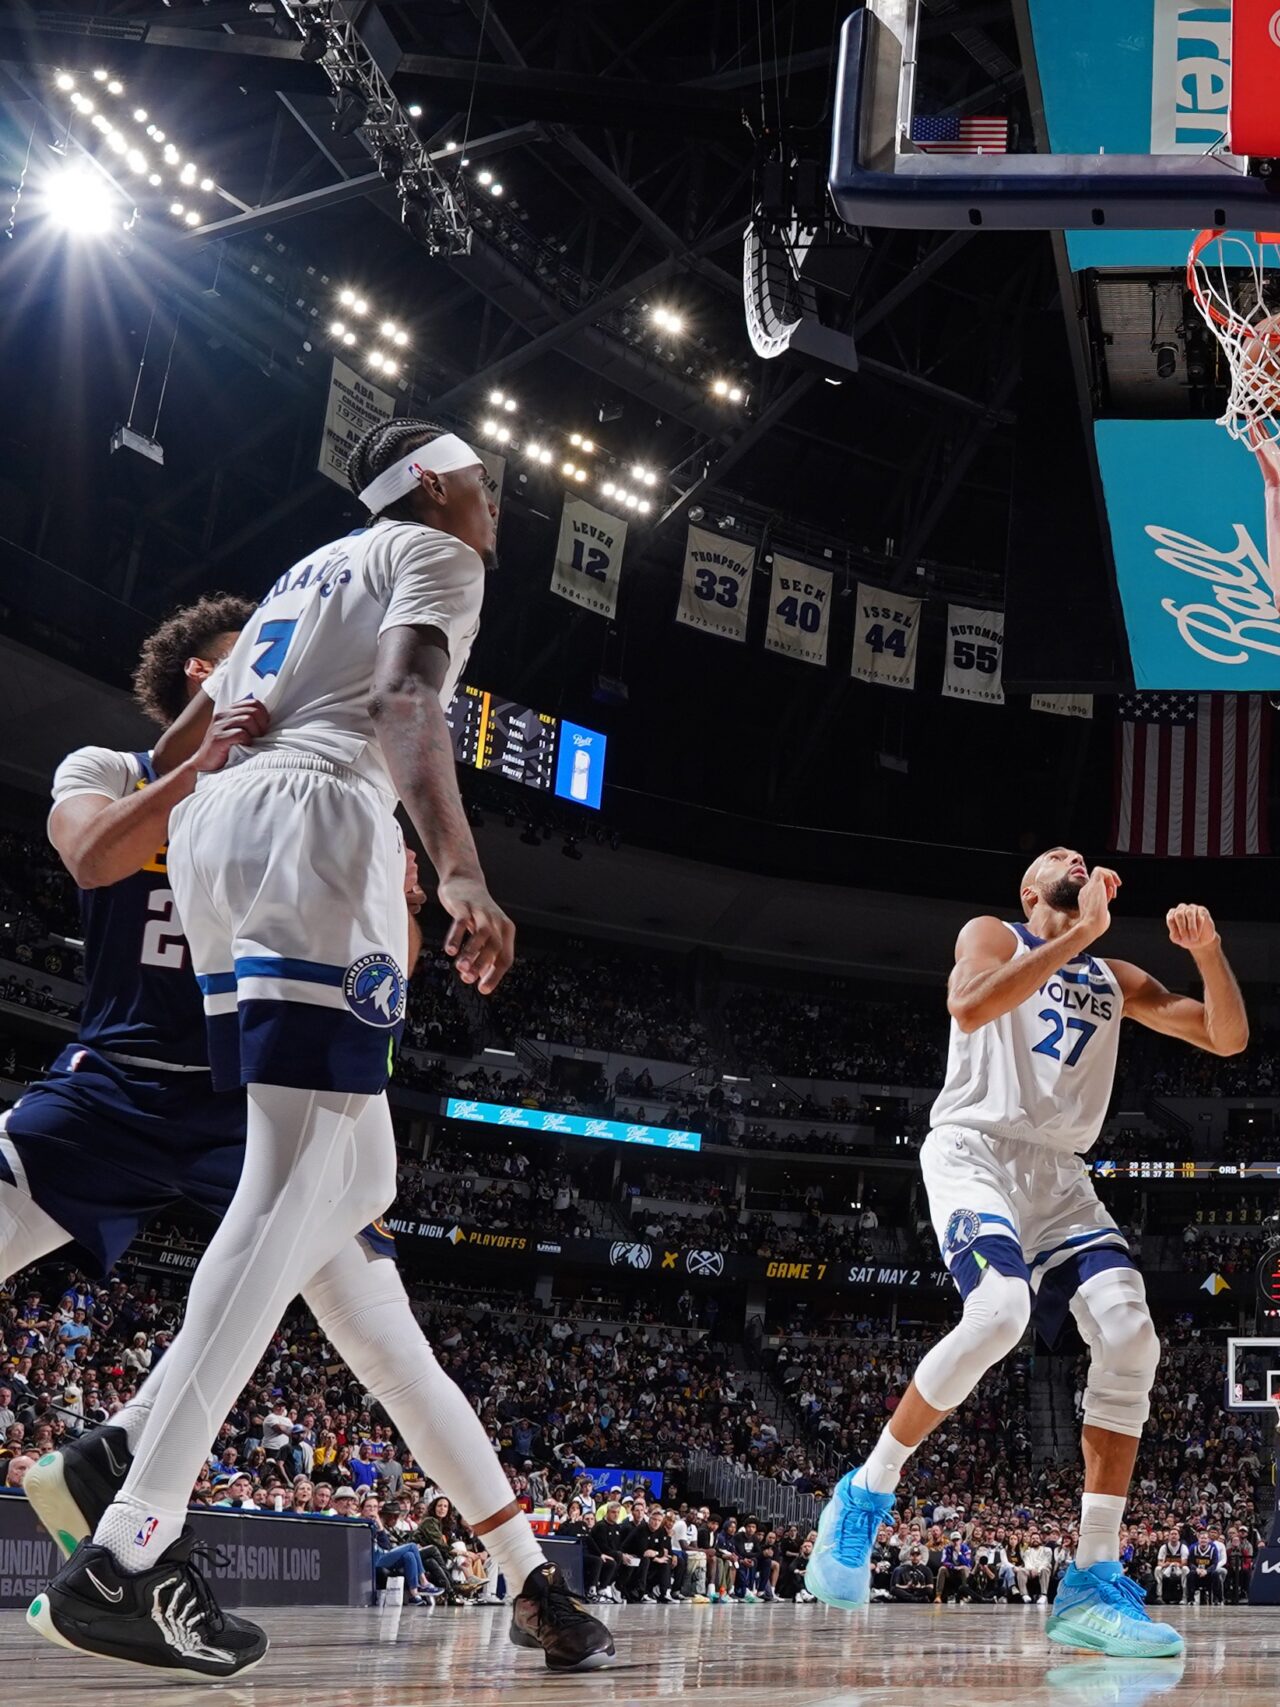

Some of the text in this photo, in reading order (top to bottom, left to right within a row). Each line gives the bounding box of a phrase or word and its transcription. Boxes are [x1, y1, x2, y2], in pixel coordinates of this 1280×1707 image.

[354, 382, 374, 401] ABA
[572, 520, 614, 549] LEVER
[571, 538, 610, 583] 12
[691, 551, 748, 577] THOMPSON
[695, 568, 739, 608] 33
[780, 578, 826, 602] BECK
[776, 595, 821, 633] 40
[863, 606, 912, 629] ISSEL
[251, 619, 299, 680] 7
[865, 624, 907, 658] 44
[953, 640, 998, 674] 55
[573, 733, 593, 748] Ball
[346, 955, 382, 996] MINNESOTA
[1040, 981, 1112, 1021] OLVES
[1032, 1008, 1098, 1067] 27
[453, 1101, 478, 1118] Ball
[499, 1107, 524, 1124] Ball
[542, 1114, 566, 1130] Ball
[584, 1120, 608, 1136] Ball
[625, 1125, 649, 1142] Ball
[666, 1131, 690, 1147] Ball
[1219, 1166, 1237, 1174] ORB
[388, 1219, 415, 1235] MILE
[418, 1222, 445, 1239] HIGH
[469, 1232, 527, 1250] PLAYOFFS
[160, 1251, 198, 1268] DENVER
[766, 1262, 812, 1280] GAME
[817, 1264, 826, 1280] 7
[848, 1267, 874, 1282] SAT
[877, 1269, 908, 1285] MAY
[910, 1270, 921, 1285] 2
[215, 1544, 320, 1581] SEASON LONG
